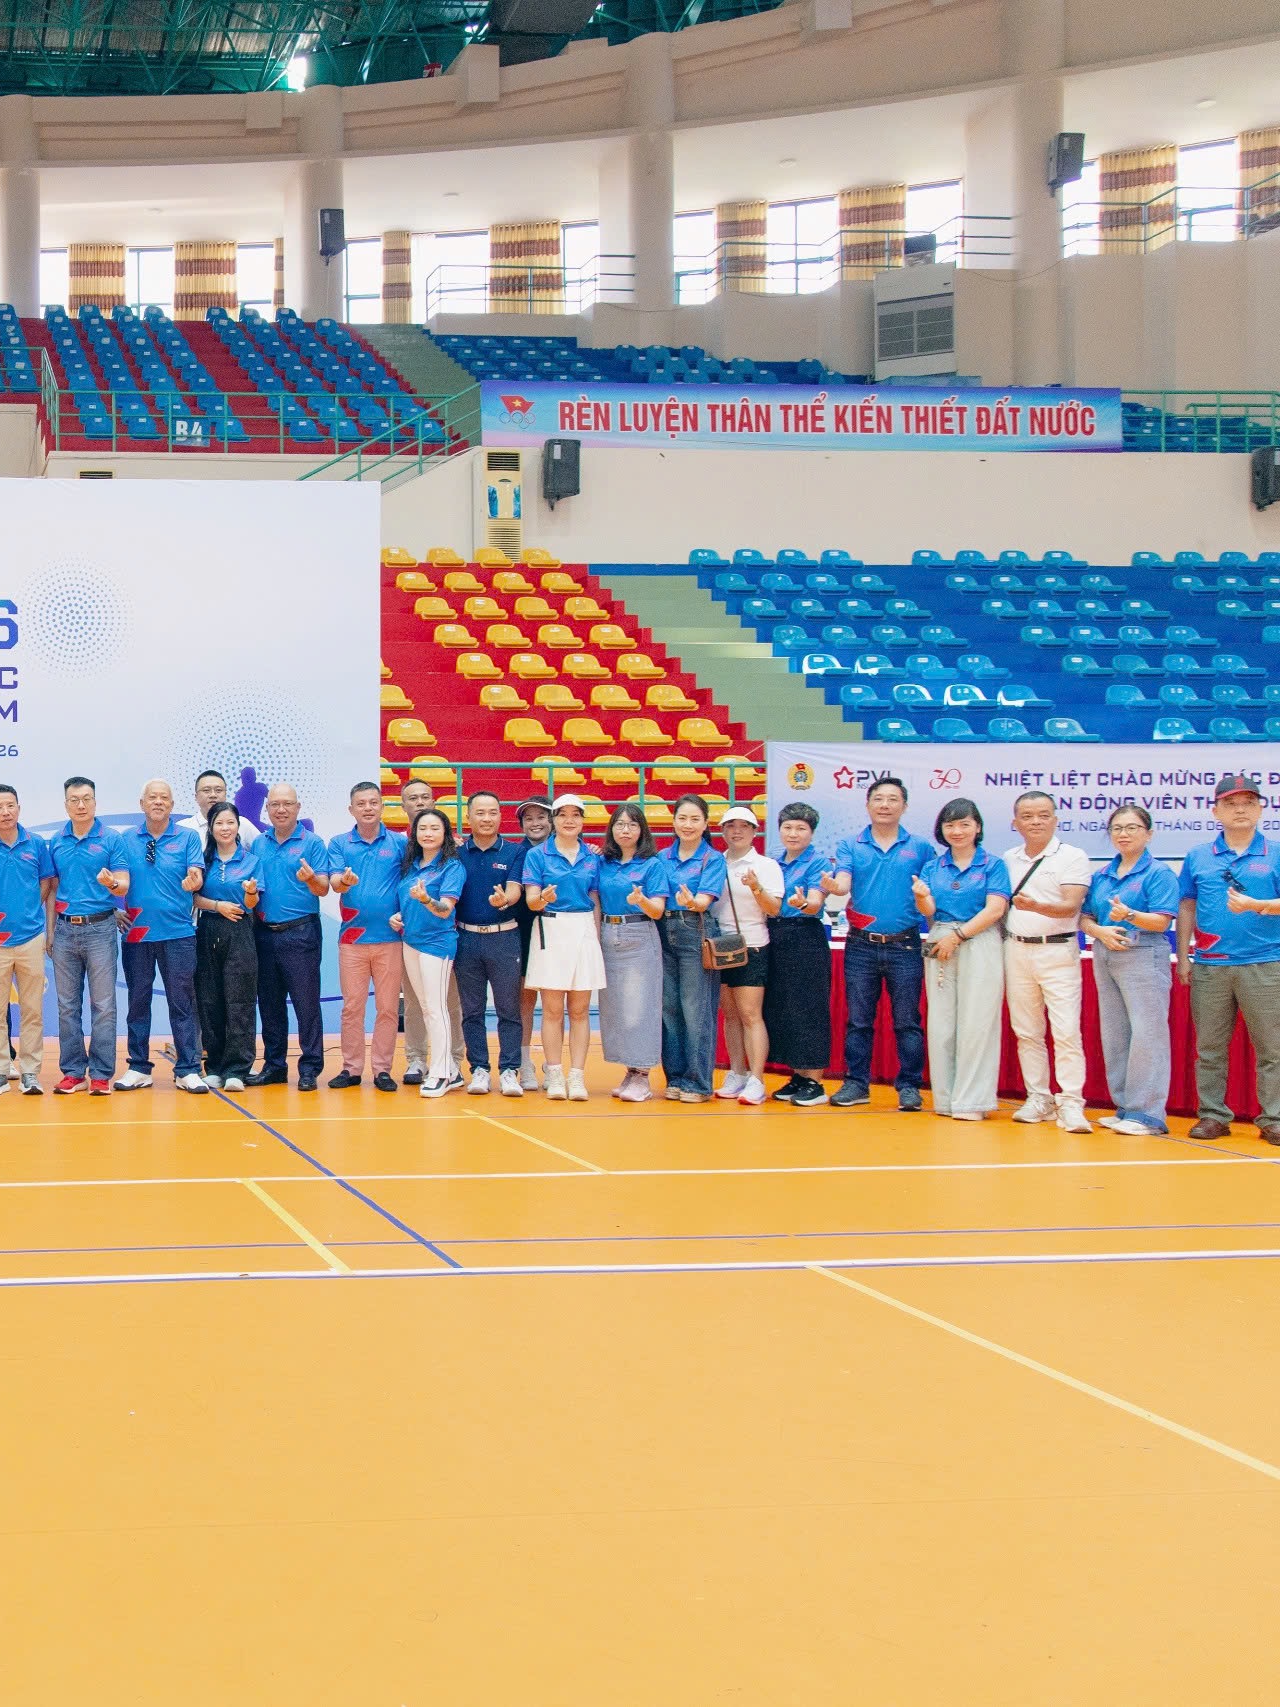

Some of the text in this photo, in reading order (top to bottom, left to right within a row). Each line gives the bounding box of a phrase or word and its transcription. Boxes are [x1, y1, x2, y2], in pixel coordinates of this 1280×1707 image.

[559, 392, 1095, 438] RÈN LUYỆN THÂN THỂ KIẾN THIẾT ĐẤT NƯỚC
[856, 770, 891, 783] PVI
[985, 769, 1044, 790] NHIỆT
[1050, 769, 1091, 790] LIỆT
[1097, 769, 1153, 786] CHÀO
[1160, 769, 1216, 786] MỪNG
[1080, 793, 1135, 813] ĐỘNG
[1142, 793, 1187, 809] VIÊN
[1193, 796, 1216, 810] TH
[1155, 818, 1202, 831] THÁNG
